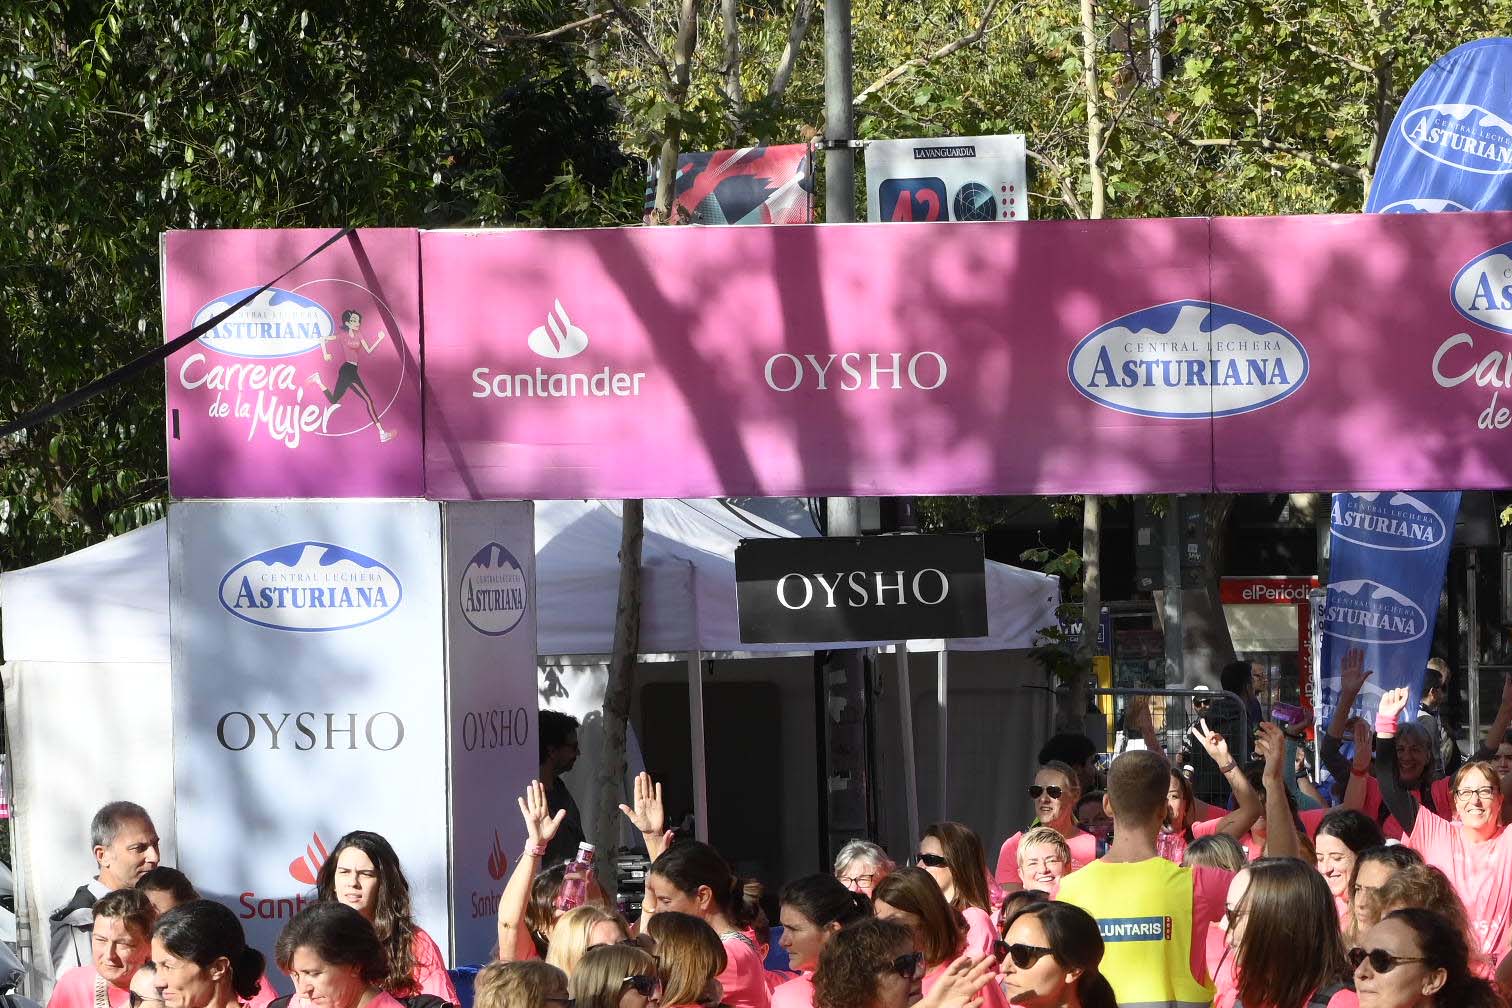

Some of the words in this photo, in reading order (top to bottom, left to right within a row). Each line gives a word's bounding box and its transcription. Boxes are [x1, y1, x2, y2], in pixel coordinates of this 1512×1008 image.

[916, 149, 925, 158] LA
[925, 147, 975, 158] VANGUARDIA
[1124, 342, 1198, 353] CENTRAL
[1207, 340, 1281, 352] LECHERA
[179, 352, 297, 391] Carrera
[471, 366, 646, 398] Santander
[764, 351, 948, 392] OYSHO
[1086, 345, 1290, 388] ASTURIANA
[208, 392, 230, 419] de
[234, 392, 251, 419] la
[248, 385, 342, 449] Mujer
[1477, 392, 1512, 429] de
[1330, 500, 1435, 542] ASTURIANA
[233, 576, 389, 610] ASTURIANA
[261, 573, 320, 583] CENTRAL
[325, 572, 382, 583] LECHERA
[465, 576, 524, 612] ASTURIANA
[776, 567, 949, 610] OYSHO
[1323, 605, 1416, 635] STURIANA
[216, 711, 405, 752] OYSHO
[462, 706, 529, 752] OYSHO
[238, 892, 309, 921] Sant
